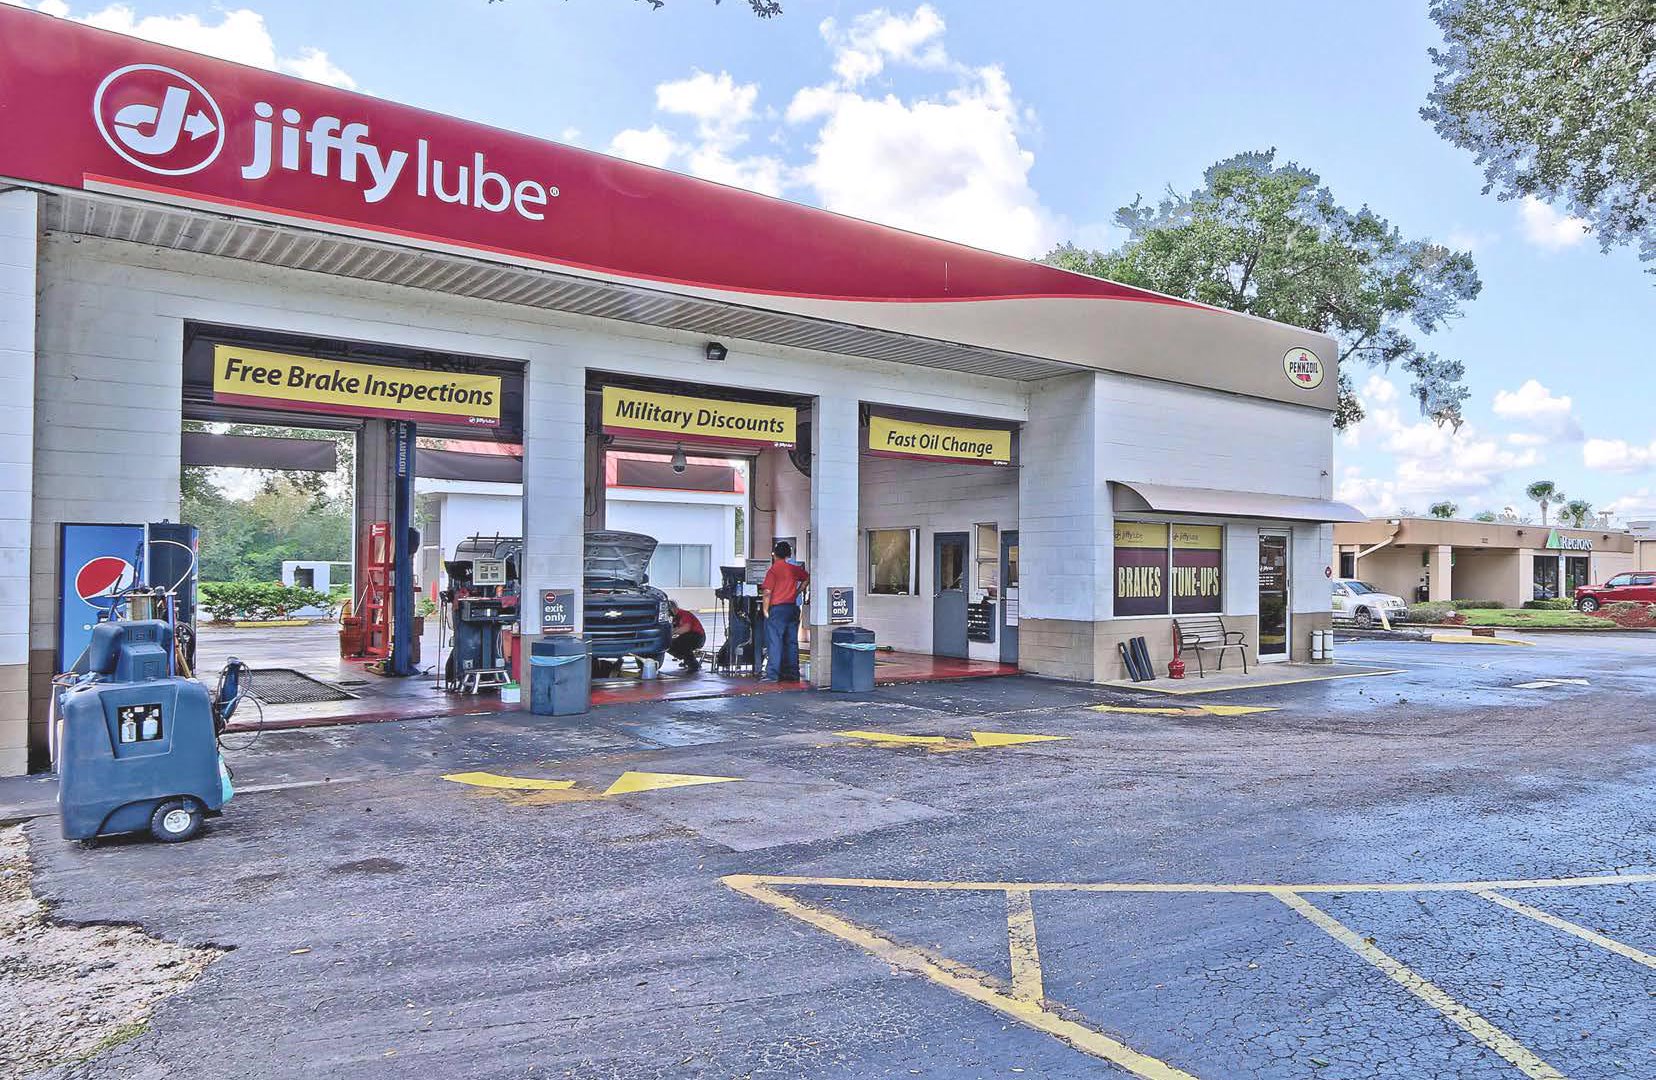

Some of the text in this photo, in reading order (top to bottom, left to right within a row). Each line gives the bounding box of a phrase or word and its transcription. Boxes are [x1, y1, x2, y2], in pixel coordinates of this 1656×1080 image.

[240, 102, 409, 203] jiffy
[224, 357, 493, 406] Free Brake Inspections
[1289, 361, 1319, 374] PENNZOIL
[615, 400, 785, 433] Military Discounts
[399, 422, 407, 473] ROTARY LIFT
[887, 430, 993, 457] Fast Oil Change
[1118, 566, 1161, 598] BRAKES
[1172, 566, 1219, 597] TUNE-UPS
[545, 603, 564, 612] exit
[832, 598, 847, 607] exit
[832, 606, 849, 615] only
[544, 613, 567, 623] only
